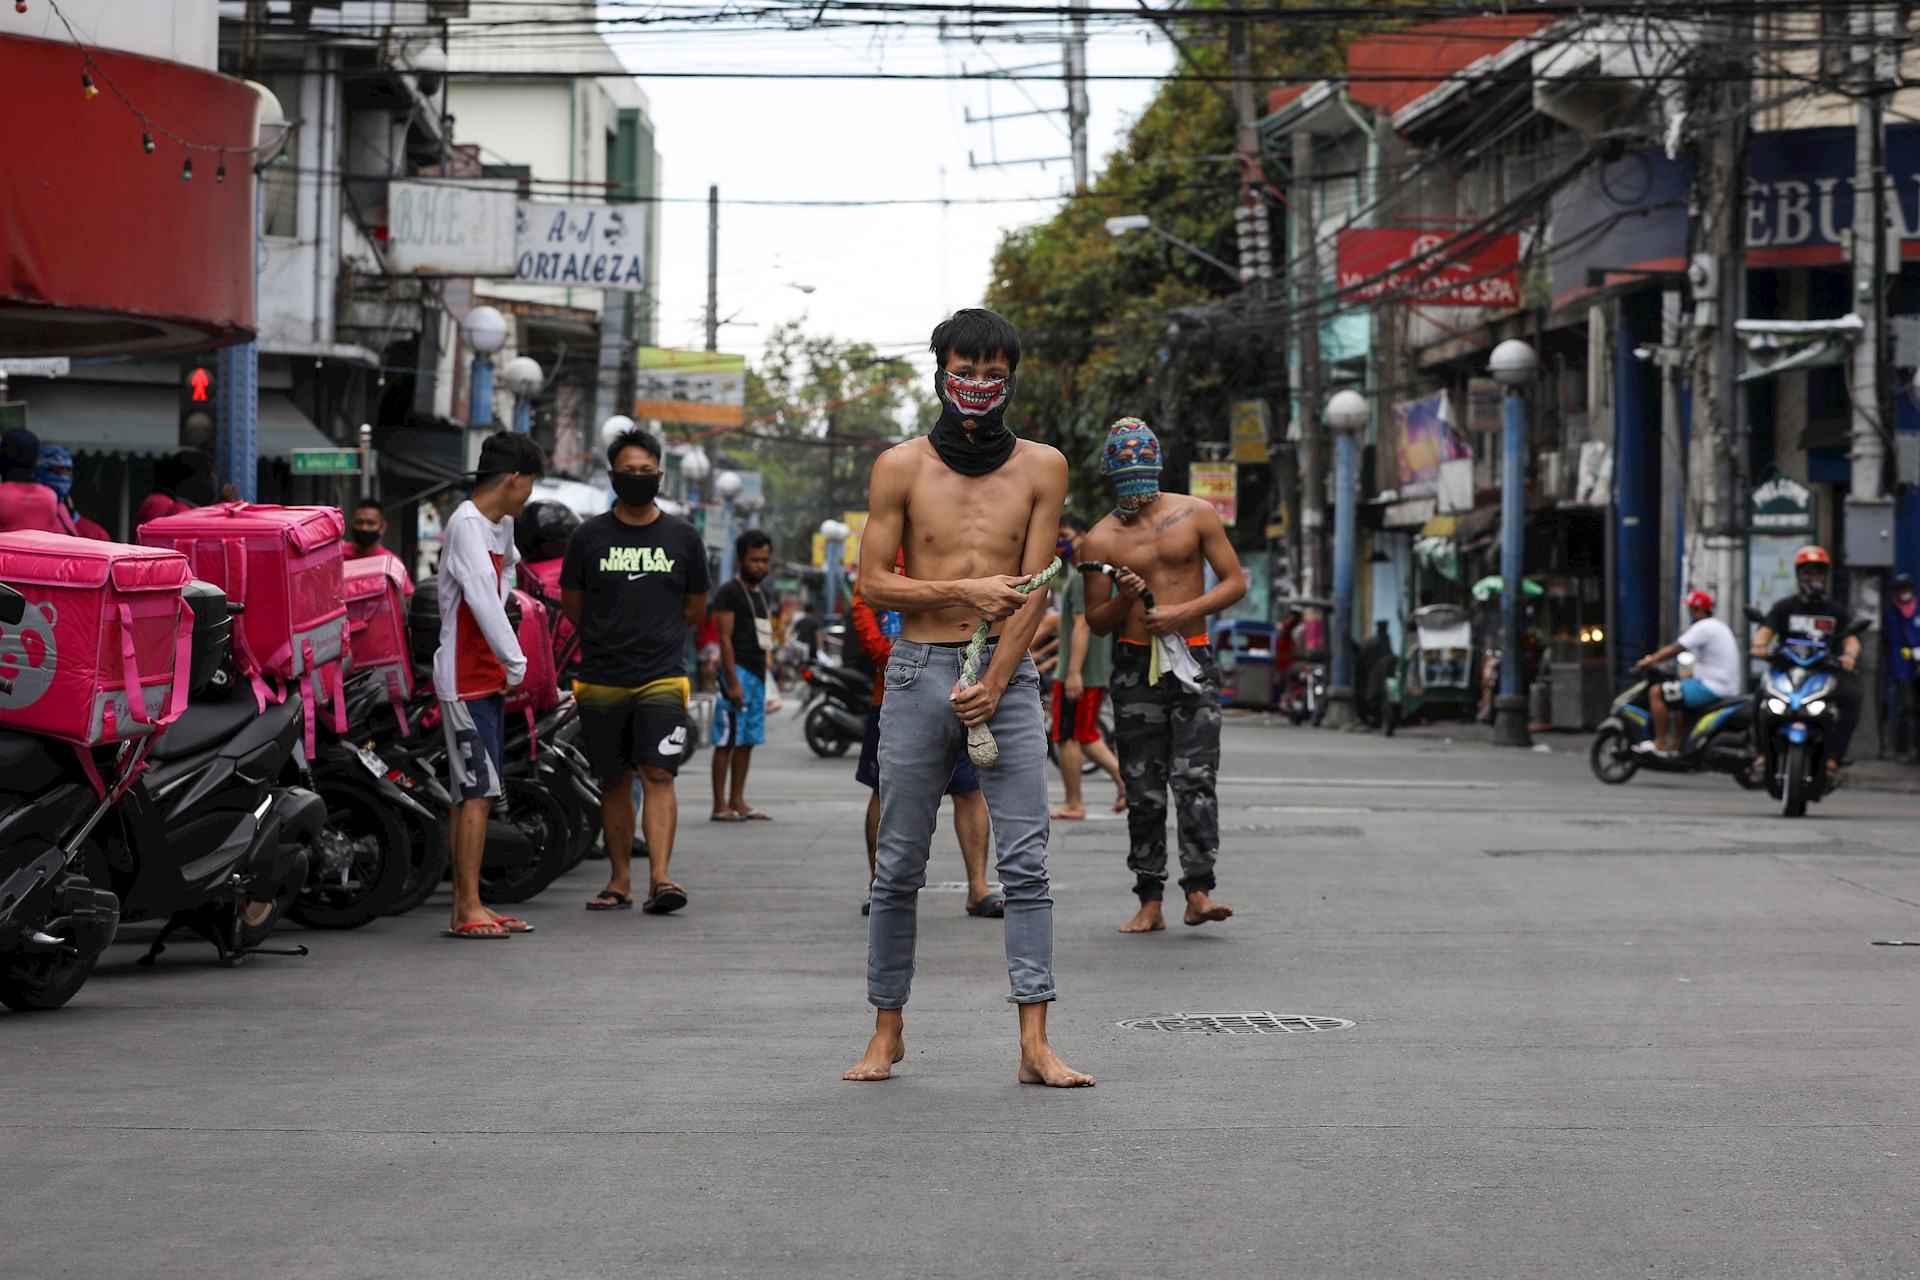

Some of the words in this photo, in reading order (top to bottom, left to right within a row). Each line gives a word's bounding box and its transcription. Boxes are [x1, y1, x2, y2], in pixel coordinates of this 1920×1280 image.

[1479, 278, 1515, 302] SPA
[609, 546, 652, 560] HAVE
[653, 546, 667, 560] A
[600, 557, 641, 572] NIKE
[642, 558, 675, 573] DAY
